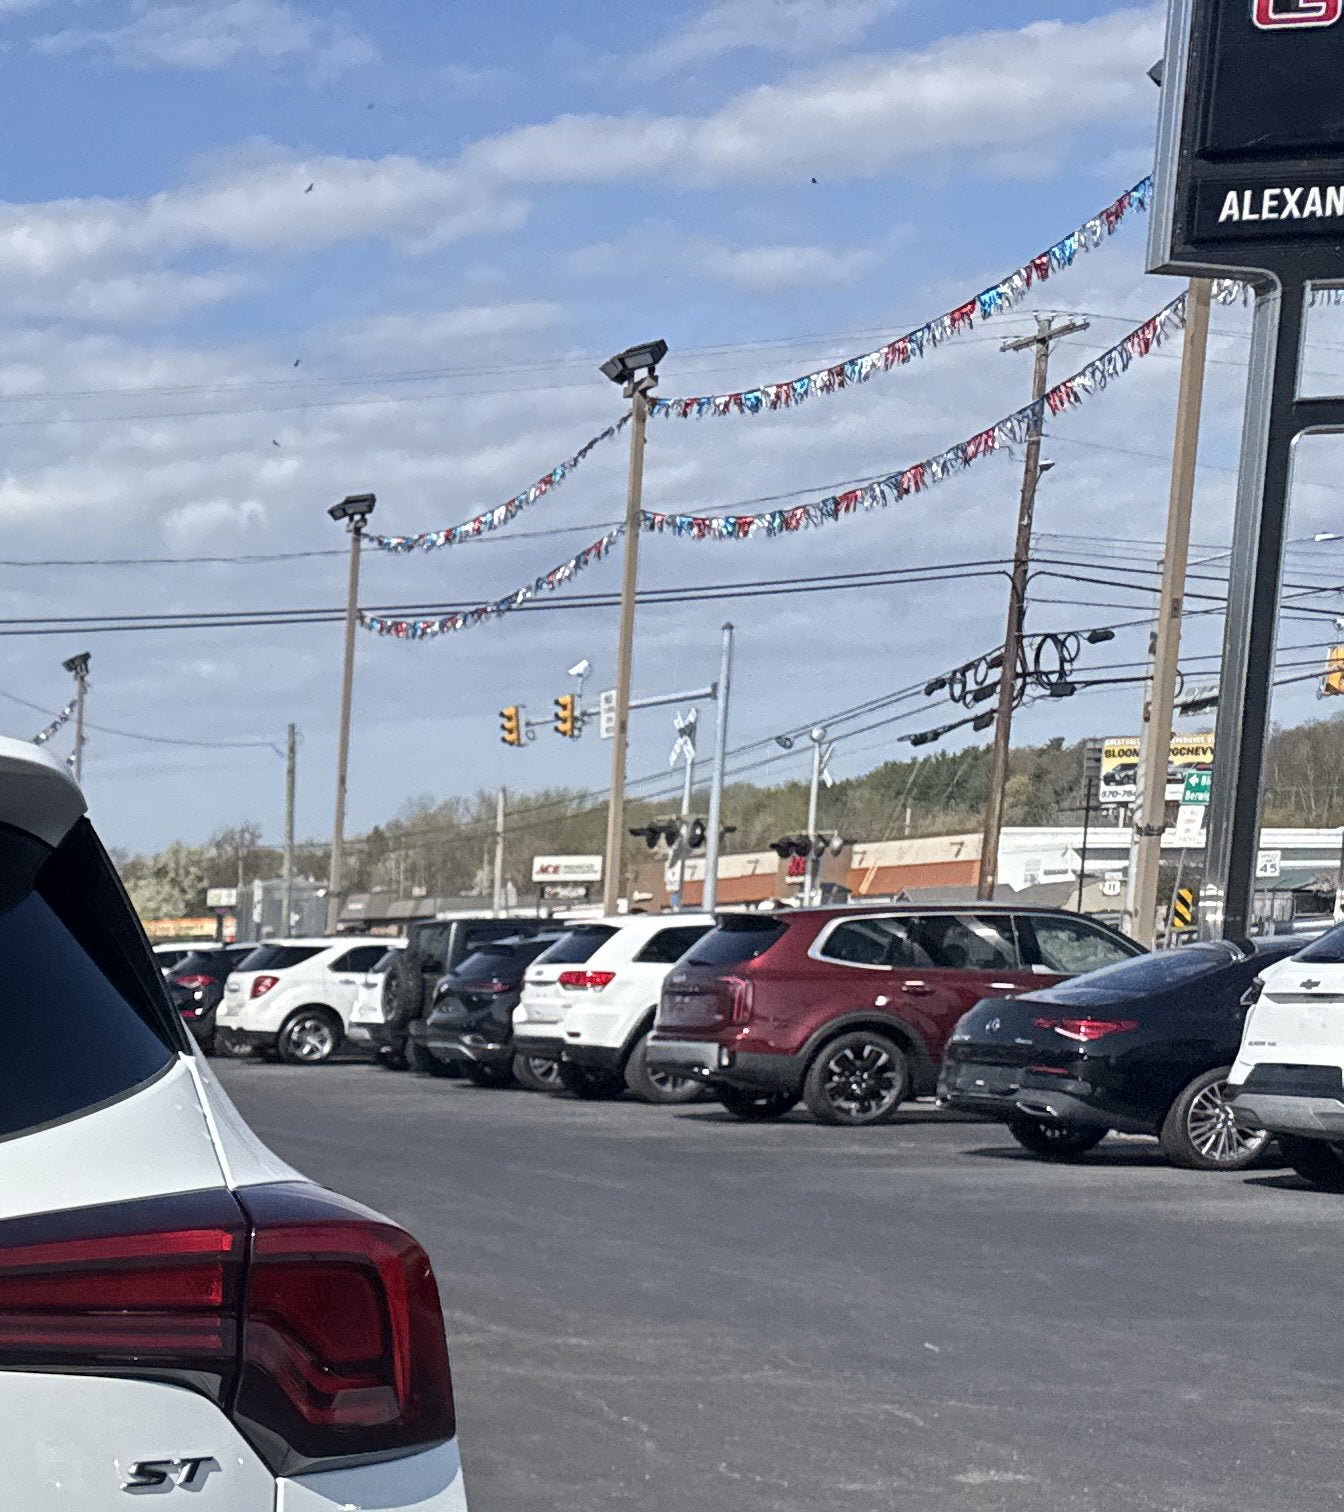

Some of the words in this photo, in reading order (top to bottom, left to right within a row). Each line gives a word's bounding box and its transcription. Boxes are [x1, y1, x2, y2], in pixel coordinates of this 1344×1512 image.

[1218, 186, 1344, 223] ALEXAN
[1259, 864, 1278, 874] 45
[119, 1456, 222, 1495] ST
